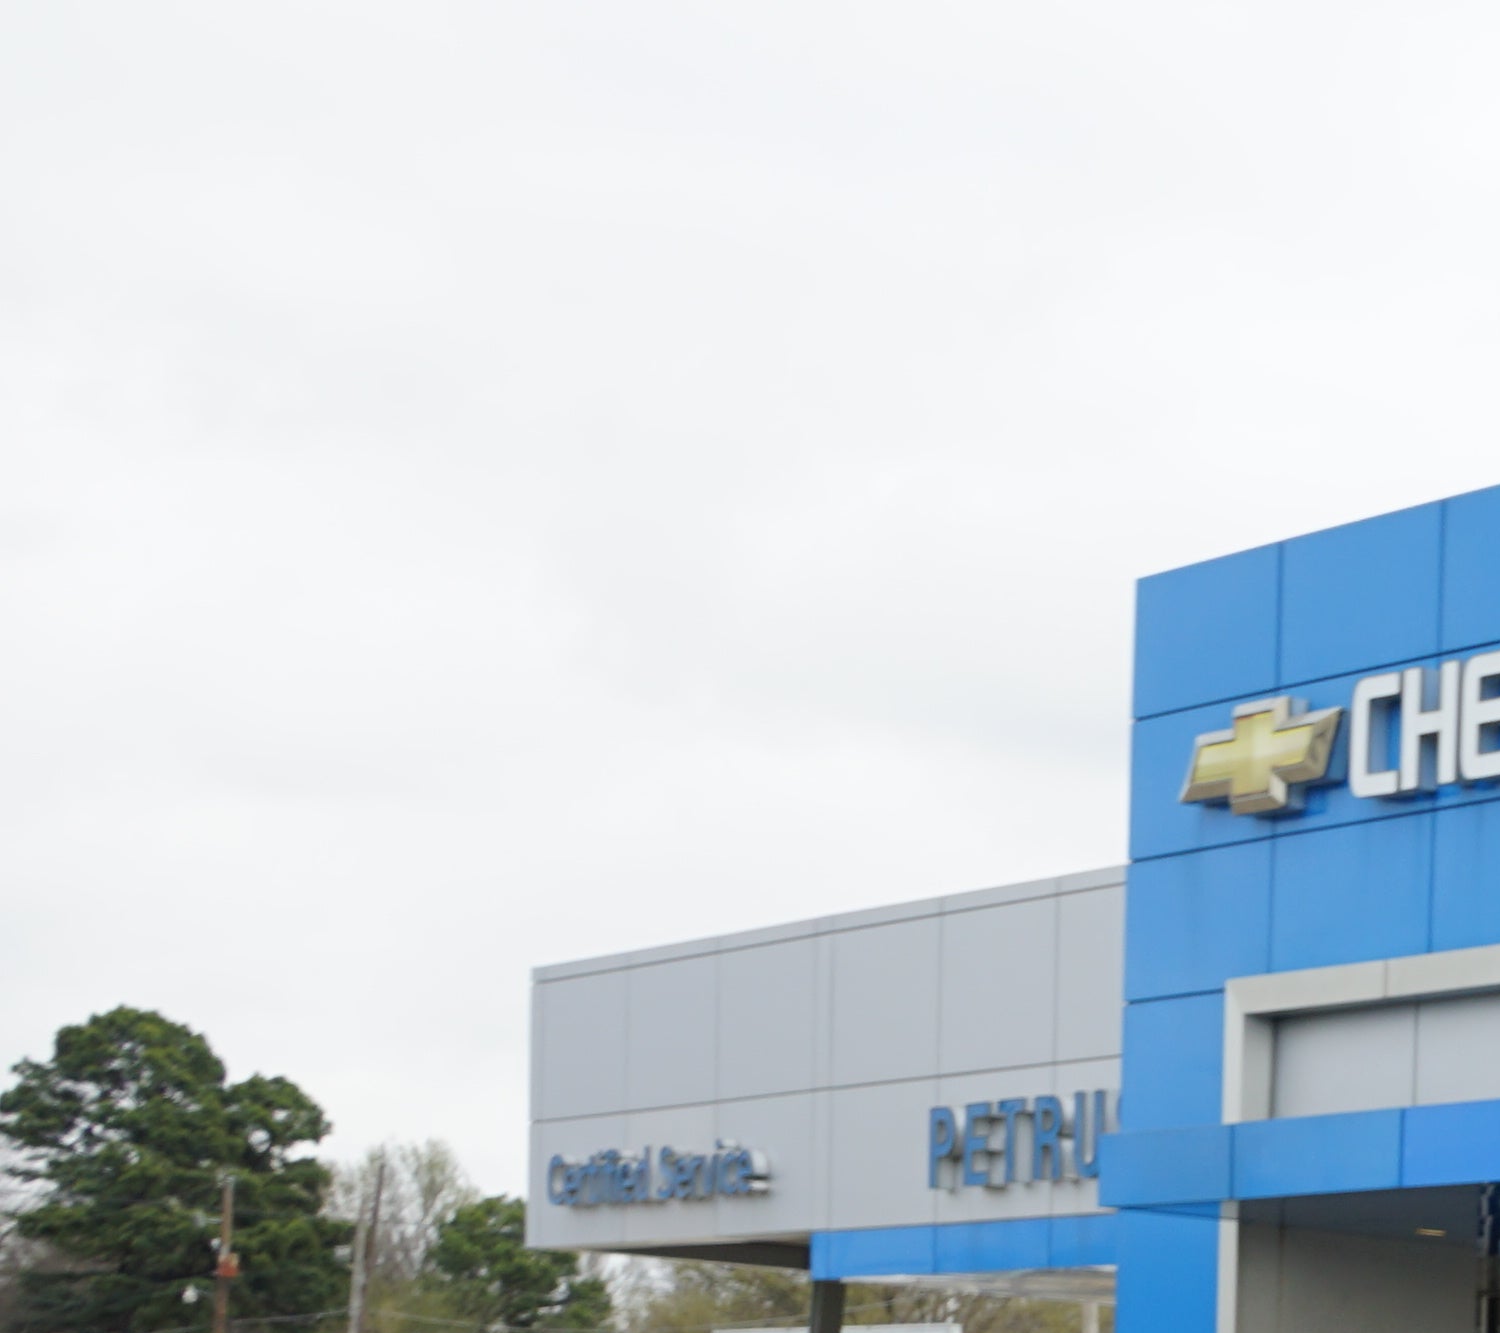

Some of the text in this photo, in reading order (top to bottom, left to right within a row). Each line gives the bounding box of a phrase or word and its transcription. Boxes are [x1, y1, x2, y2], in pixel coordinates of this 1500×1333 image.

[547, 1138, 764, 1206] Certified Service
[929, 1088, 1122, 1191] PETRU
